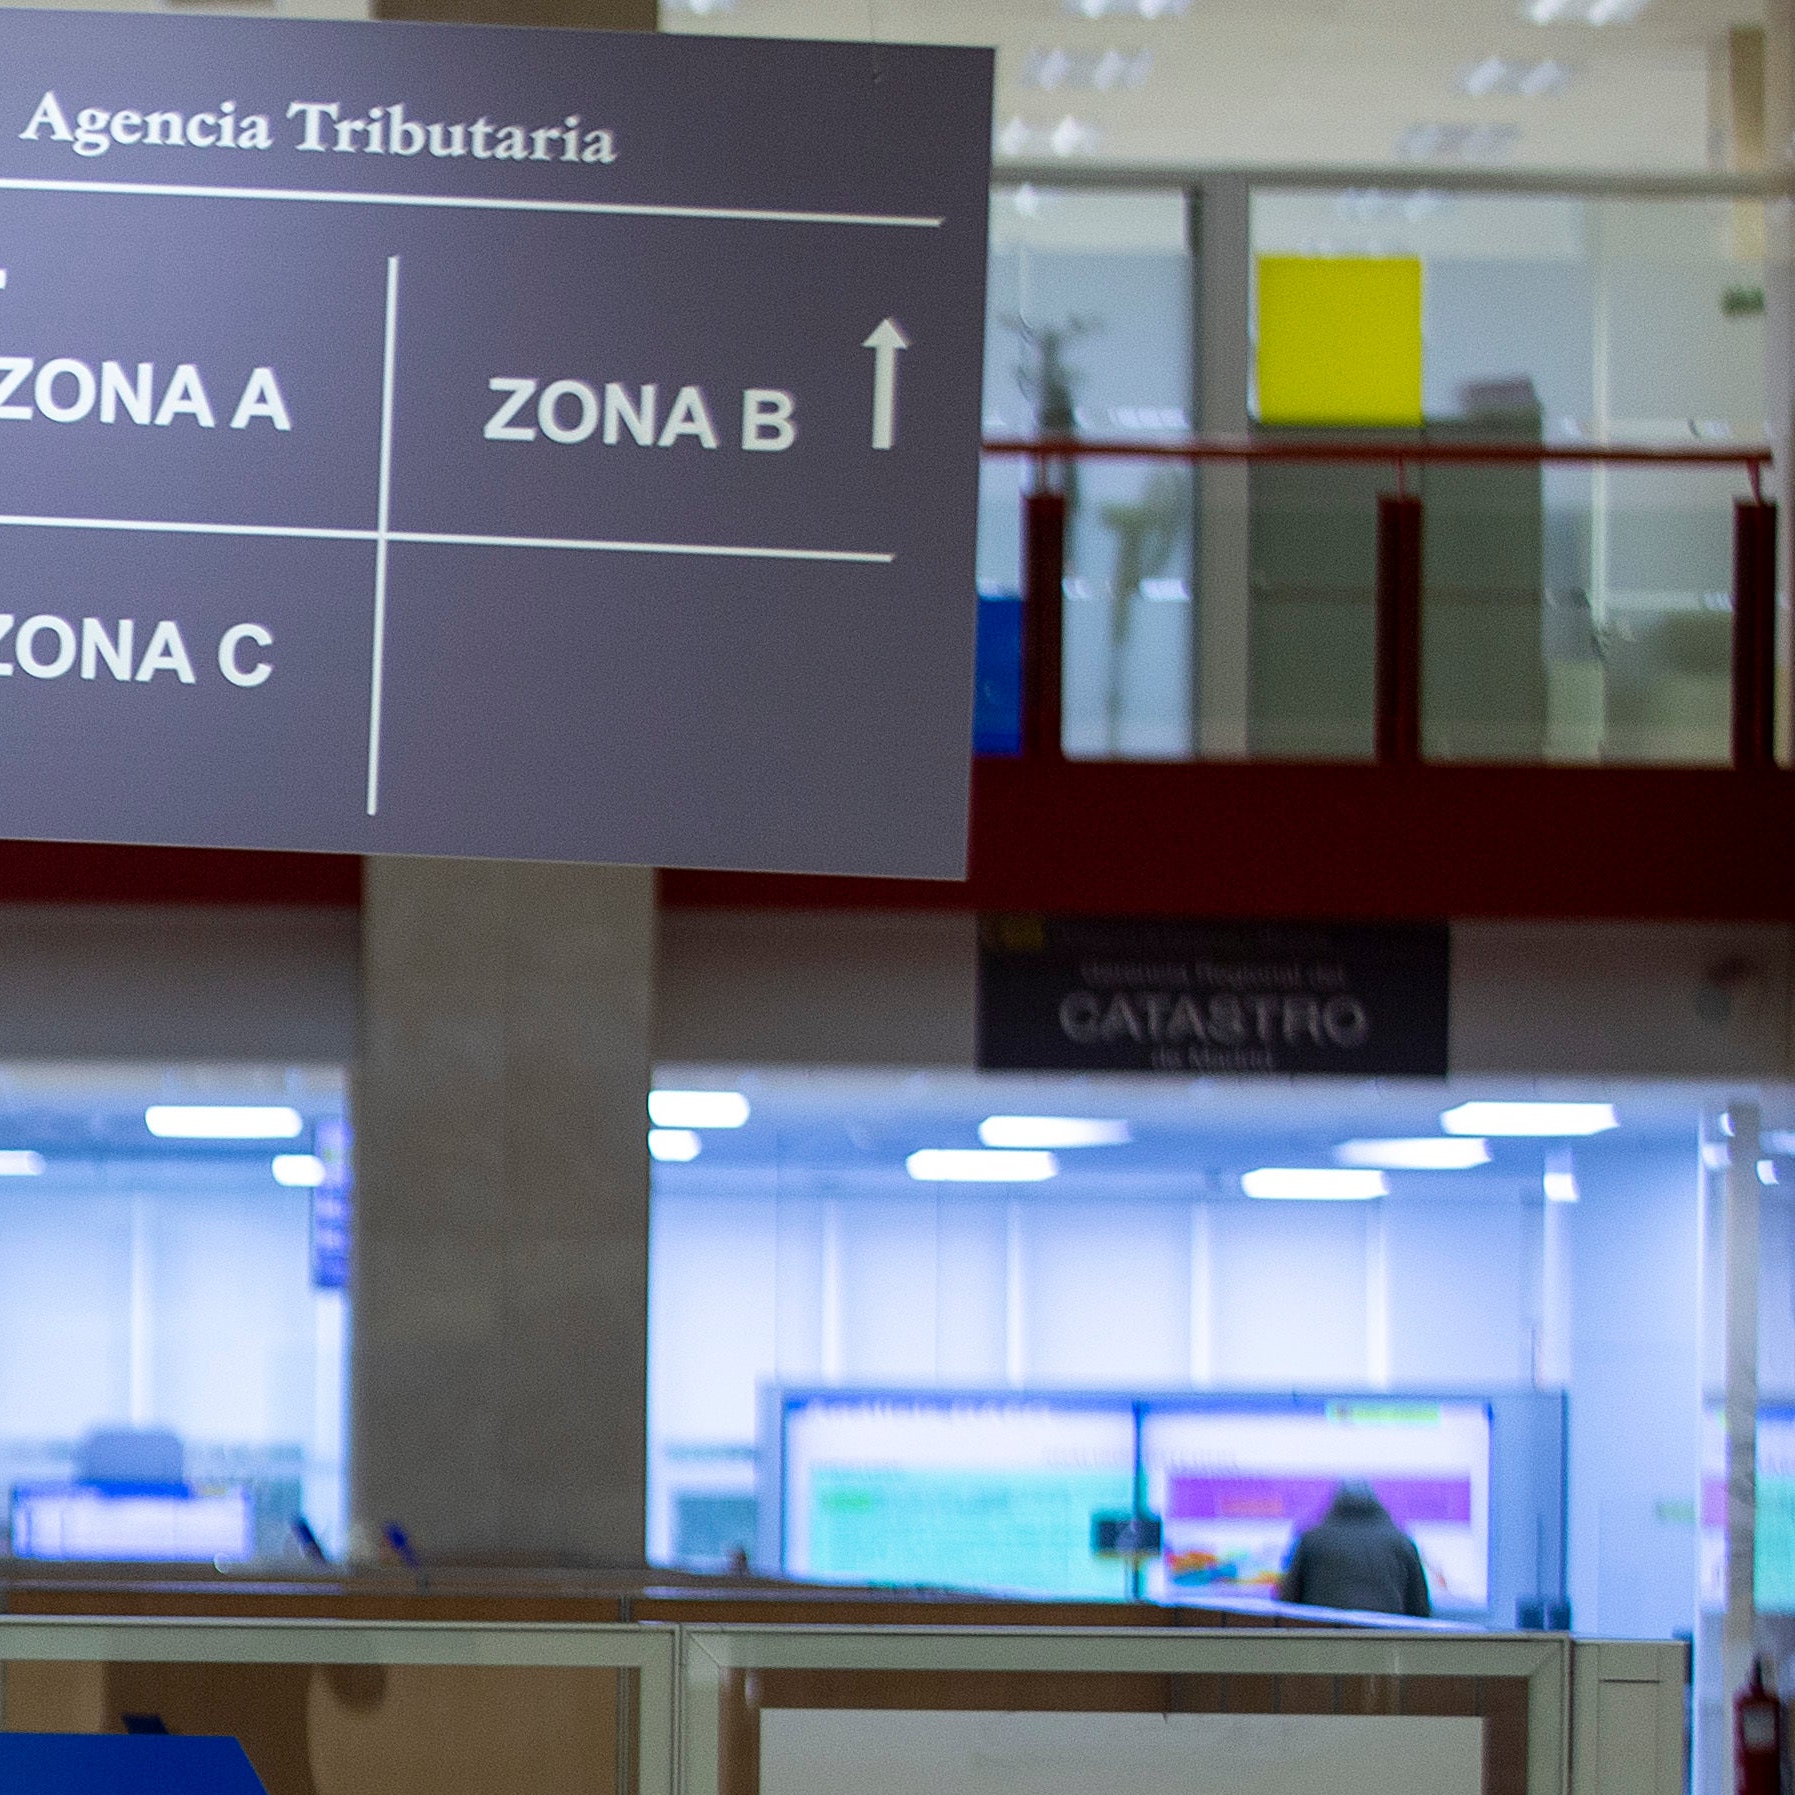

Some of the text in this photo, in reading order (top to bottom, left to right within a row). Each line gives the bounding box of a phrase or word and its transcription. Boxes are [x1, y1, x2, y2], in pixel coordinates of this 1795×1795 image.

[18, 91, 616, 164] Agencia Tributaria
[229, 366, 292, 431] A
[483, 376, 797, 452] ZONA B
[217, 622, 274, 688] C
[1058, 989, 1370, 1047] CATASTRO
